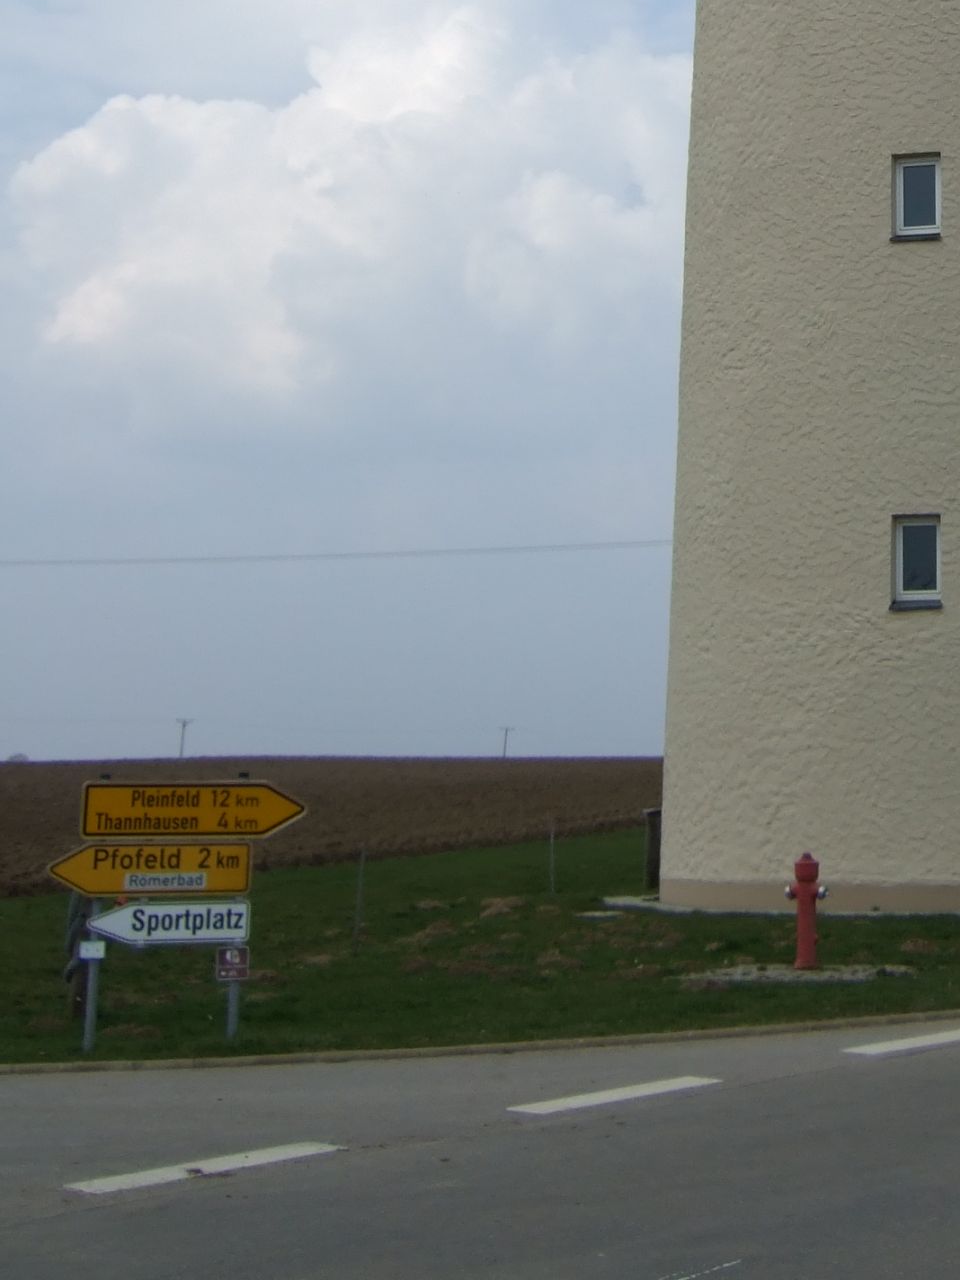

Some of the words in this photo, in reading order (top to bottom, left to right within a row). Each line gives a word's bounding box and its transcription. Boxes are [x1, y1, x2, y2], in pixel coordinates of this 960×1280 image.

[131, 790, 199, 808] Pleinfeld
[211, 790, 229, 807] 12
[236, 795, 259, 807] km
[96, 813, 198, 831] Thannhausen
[217, 812, 228, 829] 4
[234, 817, 258, 830] km
[93, 848, 180, 869] Pfofeld
[198, 848, 210, 868] 2
[216, 851, 239, 867] km
[131, 908, 244, 935] Sportplatz
